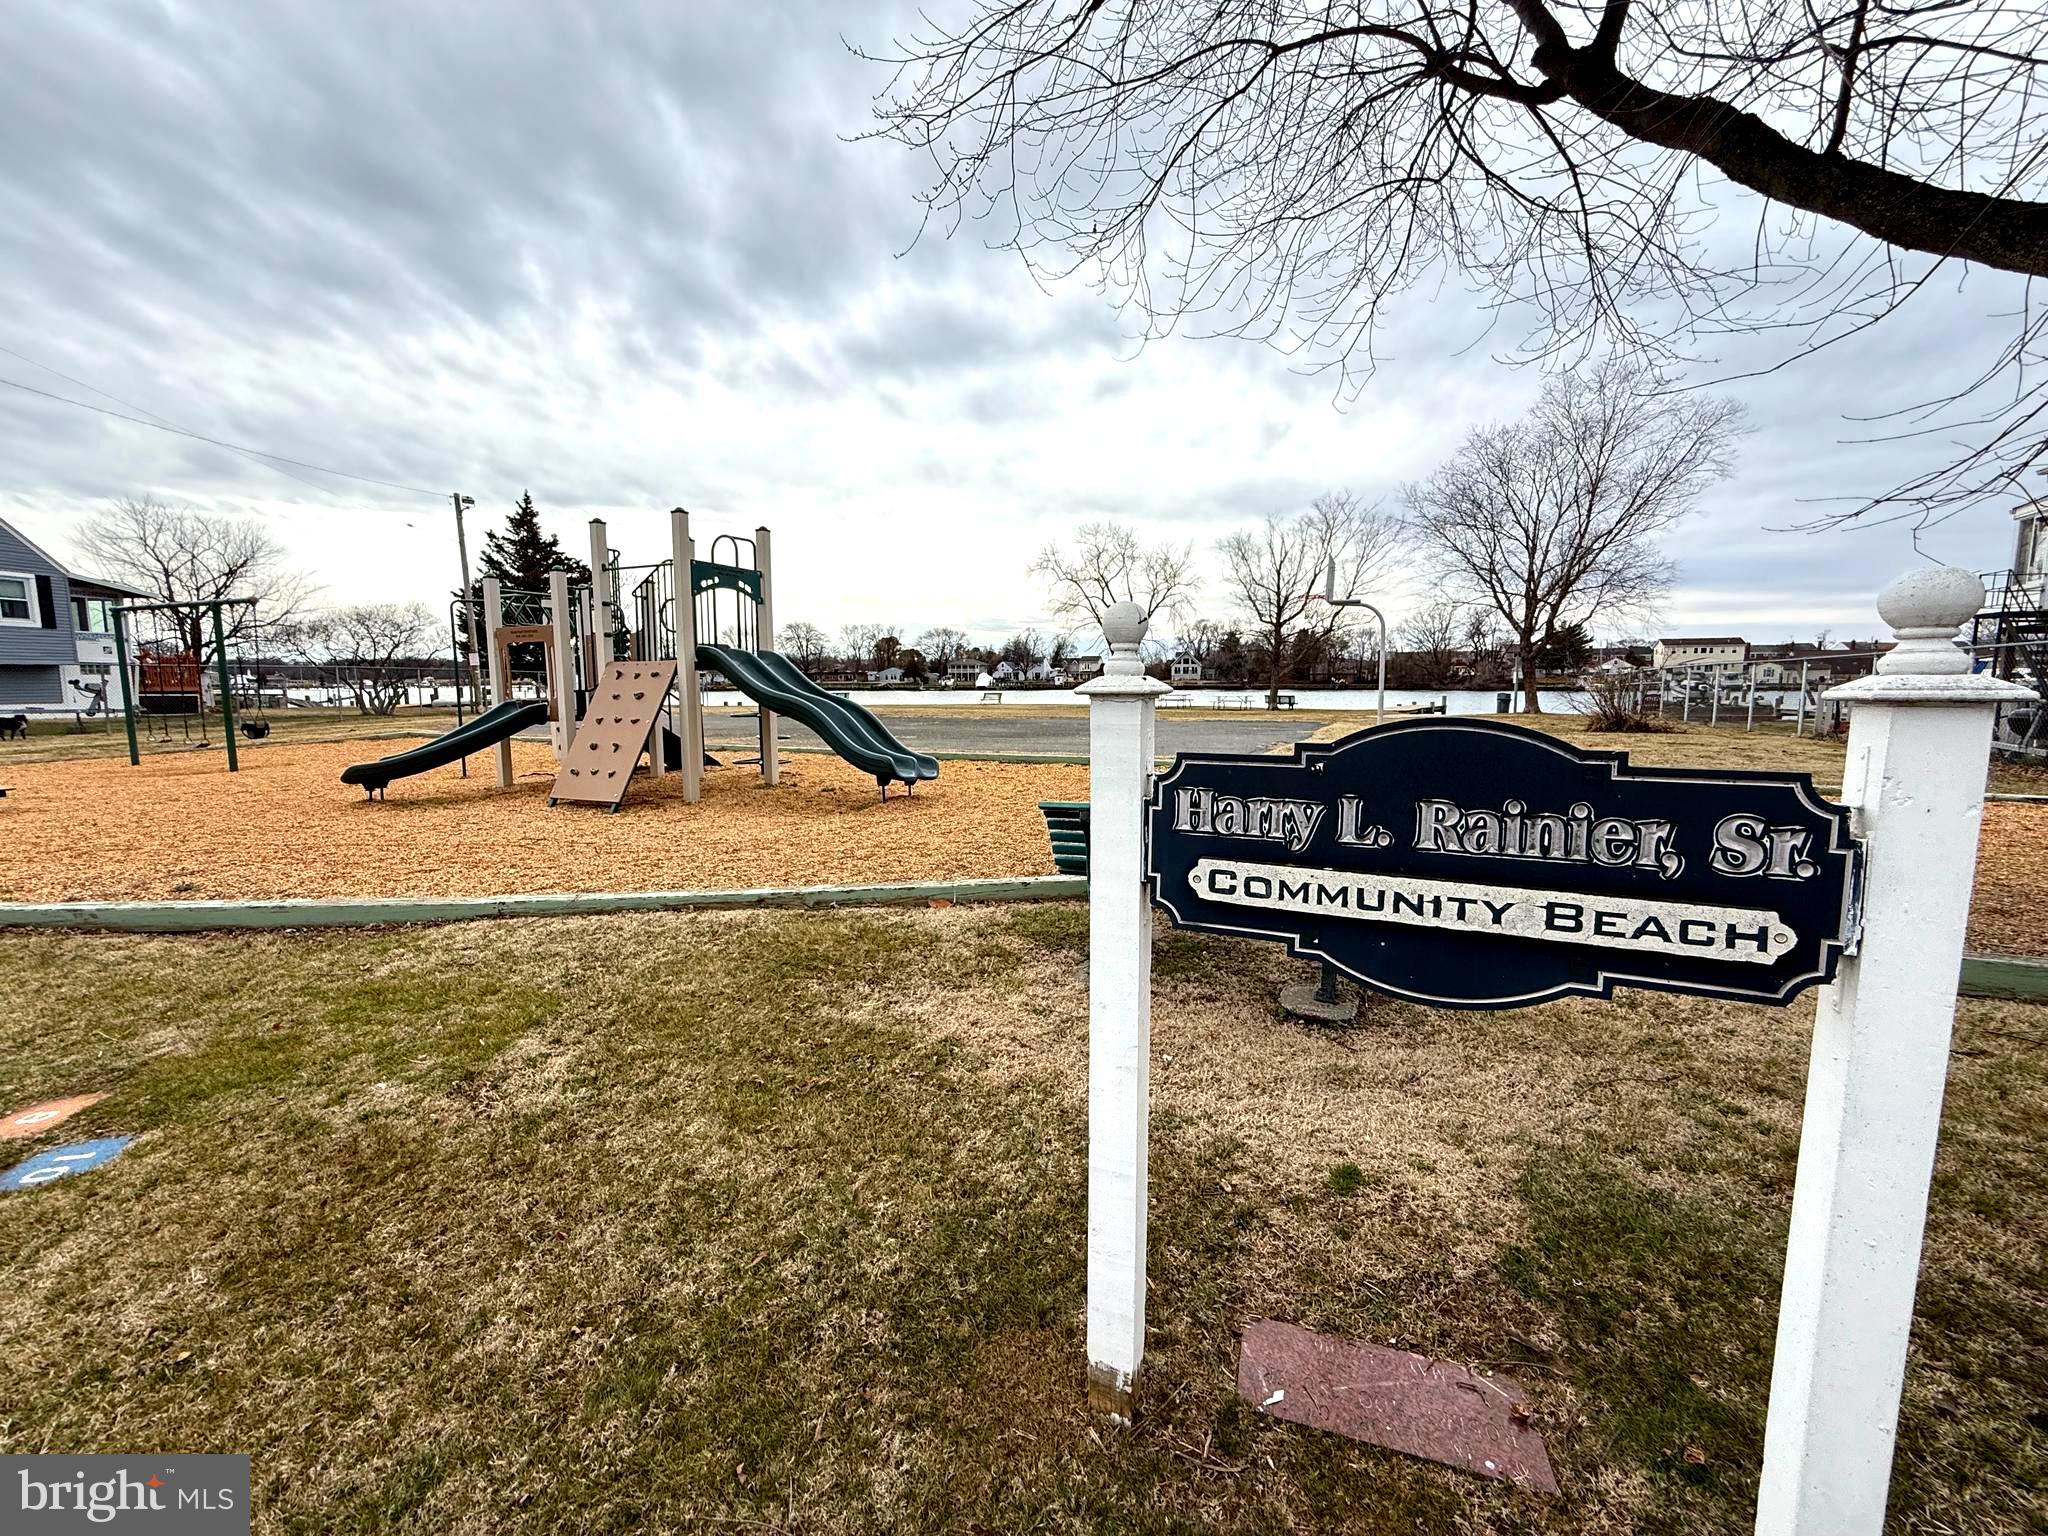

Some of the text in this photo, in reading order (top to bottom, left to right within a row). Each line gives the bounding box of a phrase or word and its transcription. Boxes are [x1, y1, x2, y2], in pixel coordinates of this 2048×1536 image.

[1174, 787, 1821, 881] Harry L. Rainier, Sr.
[1208, 869, 1769, 953] COMMUNITY BEACH
